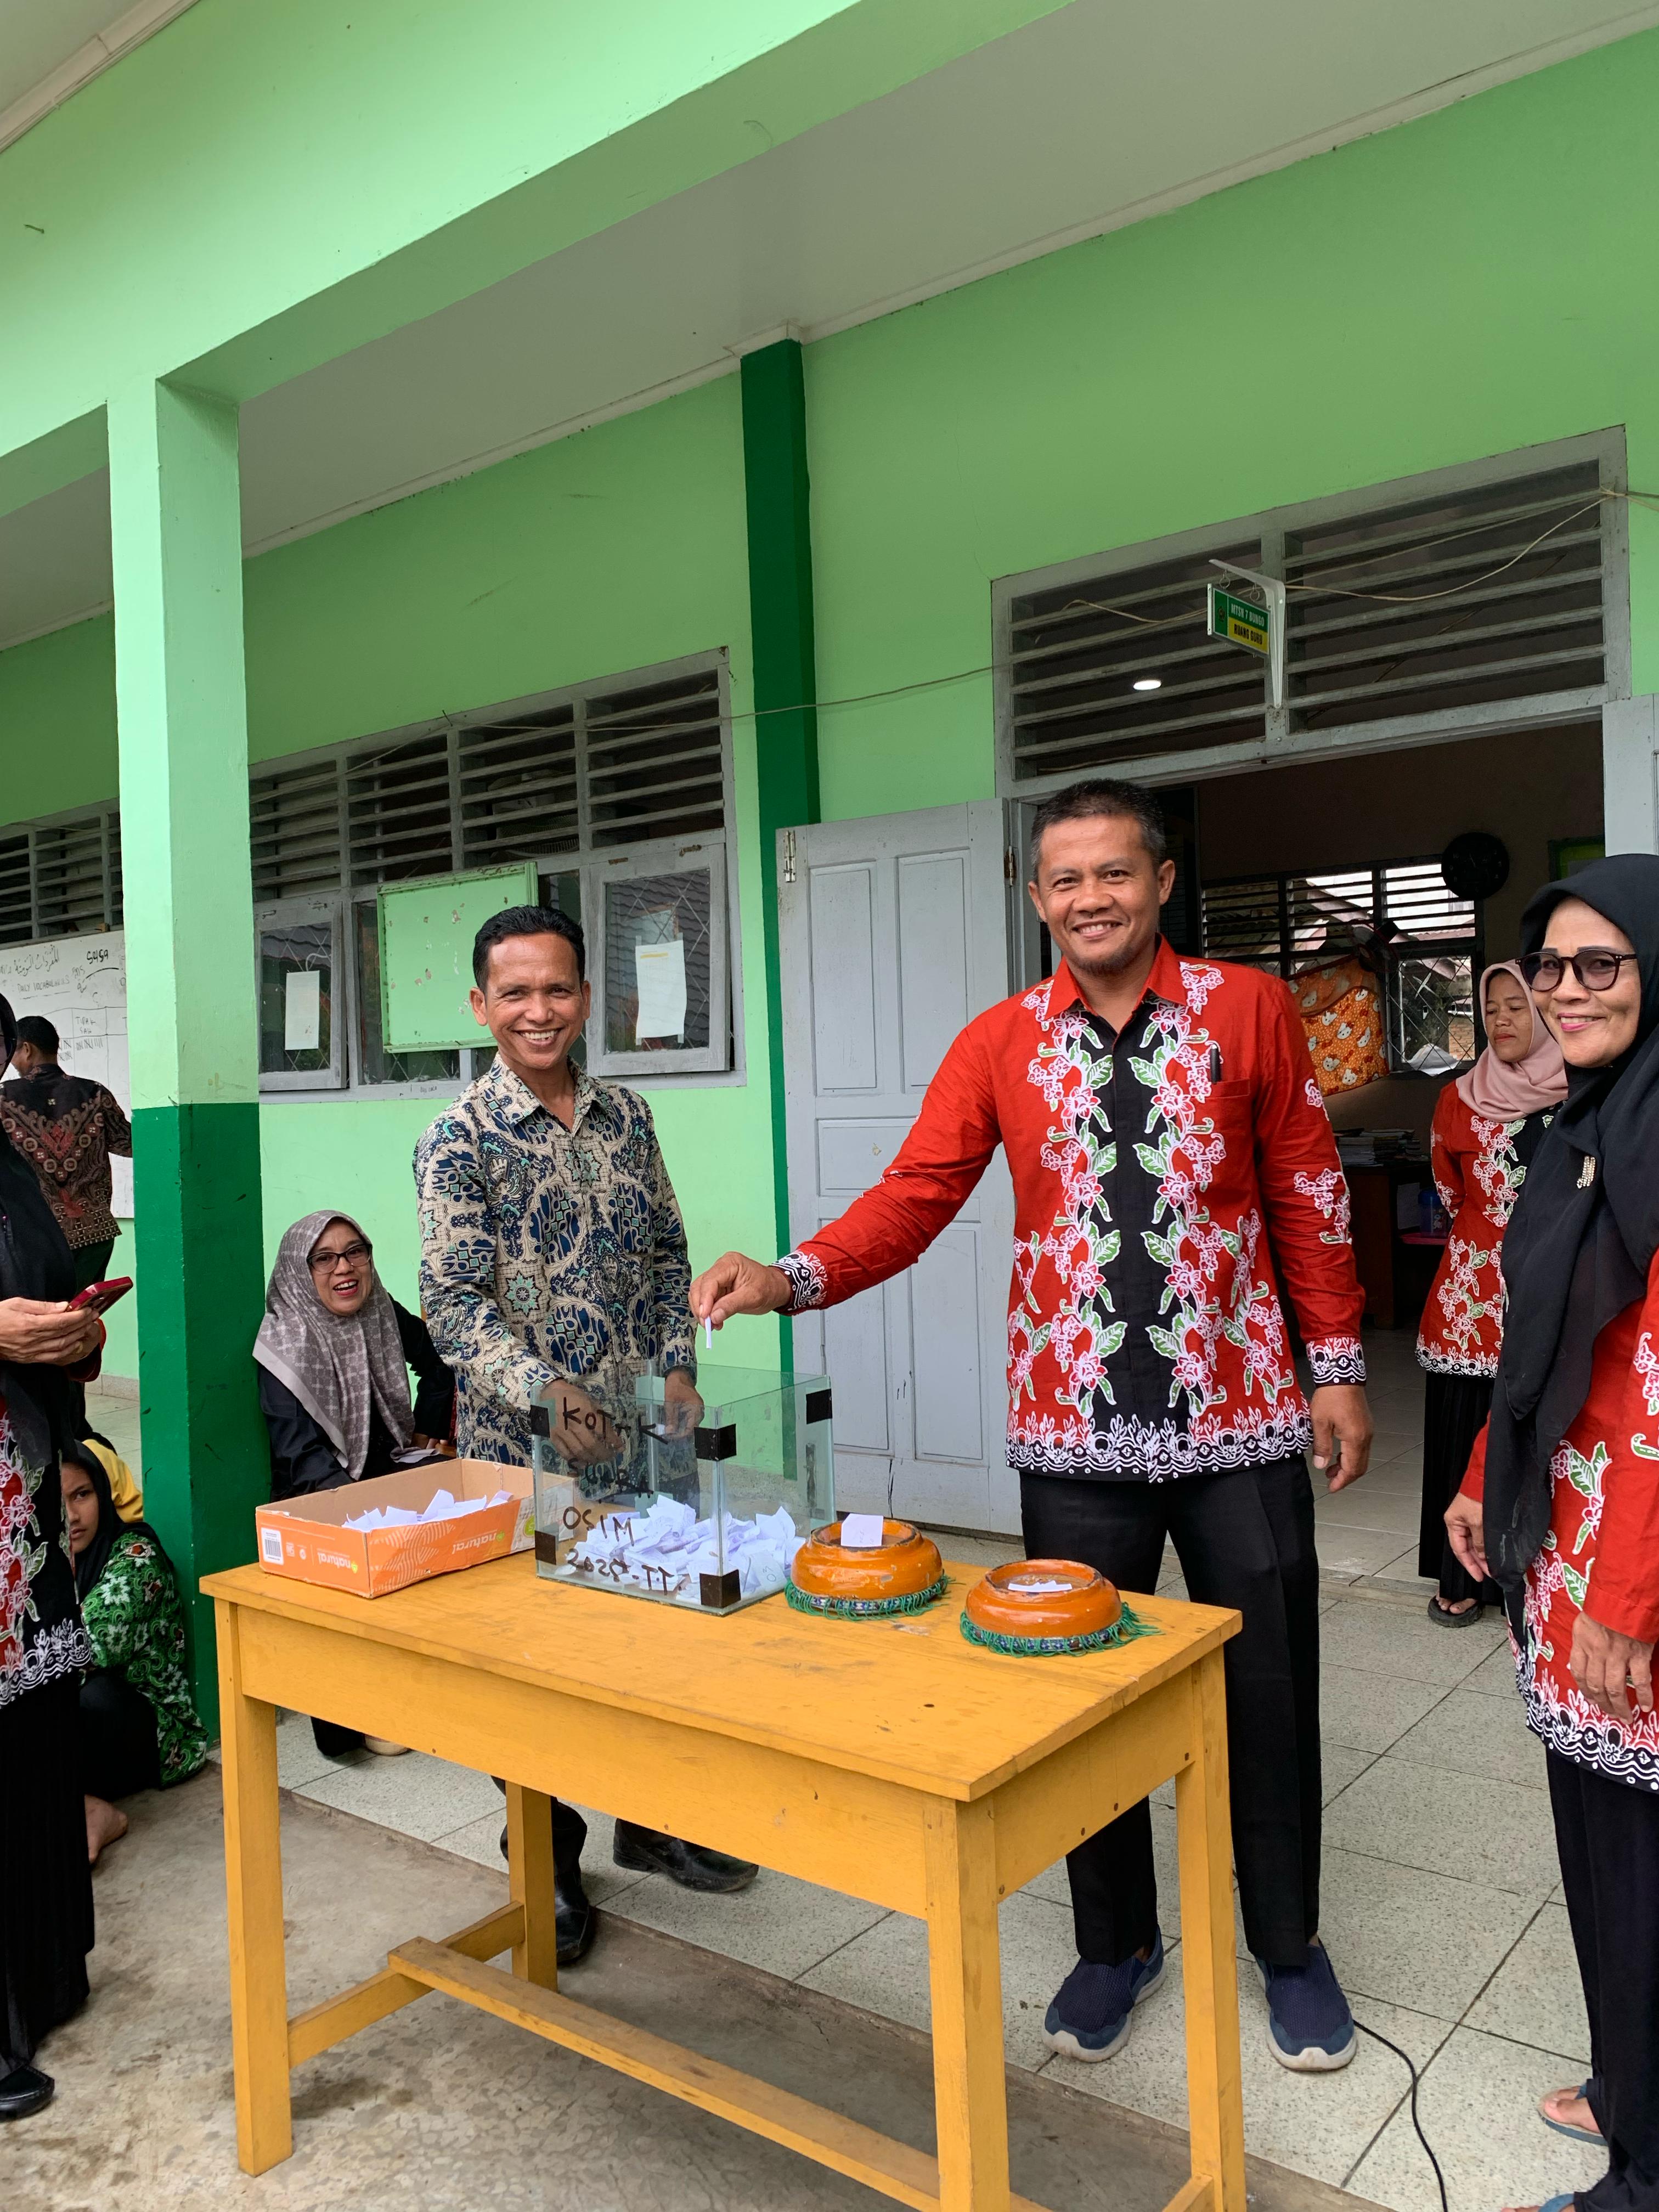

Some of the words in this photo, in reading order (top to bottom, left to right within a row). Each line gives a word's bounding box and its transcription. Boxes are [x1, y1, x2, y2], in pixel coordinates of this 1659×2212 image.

[1245, 610, 1248, 619] 7
[1249, 611, 1265, 627] BUNGO
[1234, 623, 1249, 640] RUANG
[1250, 630, 1263, 645] GURU
[563, 1506, 635, 1547] OSIM
[451, 1532, 497, 1555] natural
[317, 1551, 351, 1569] natural
